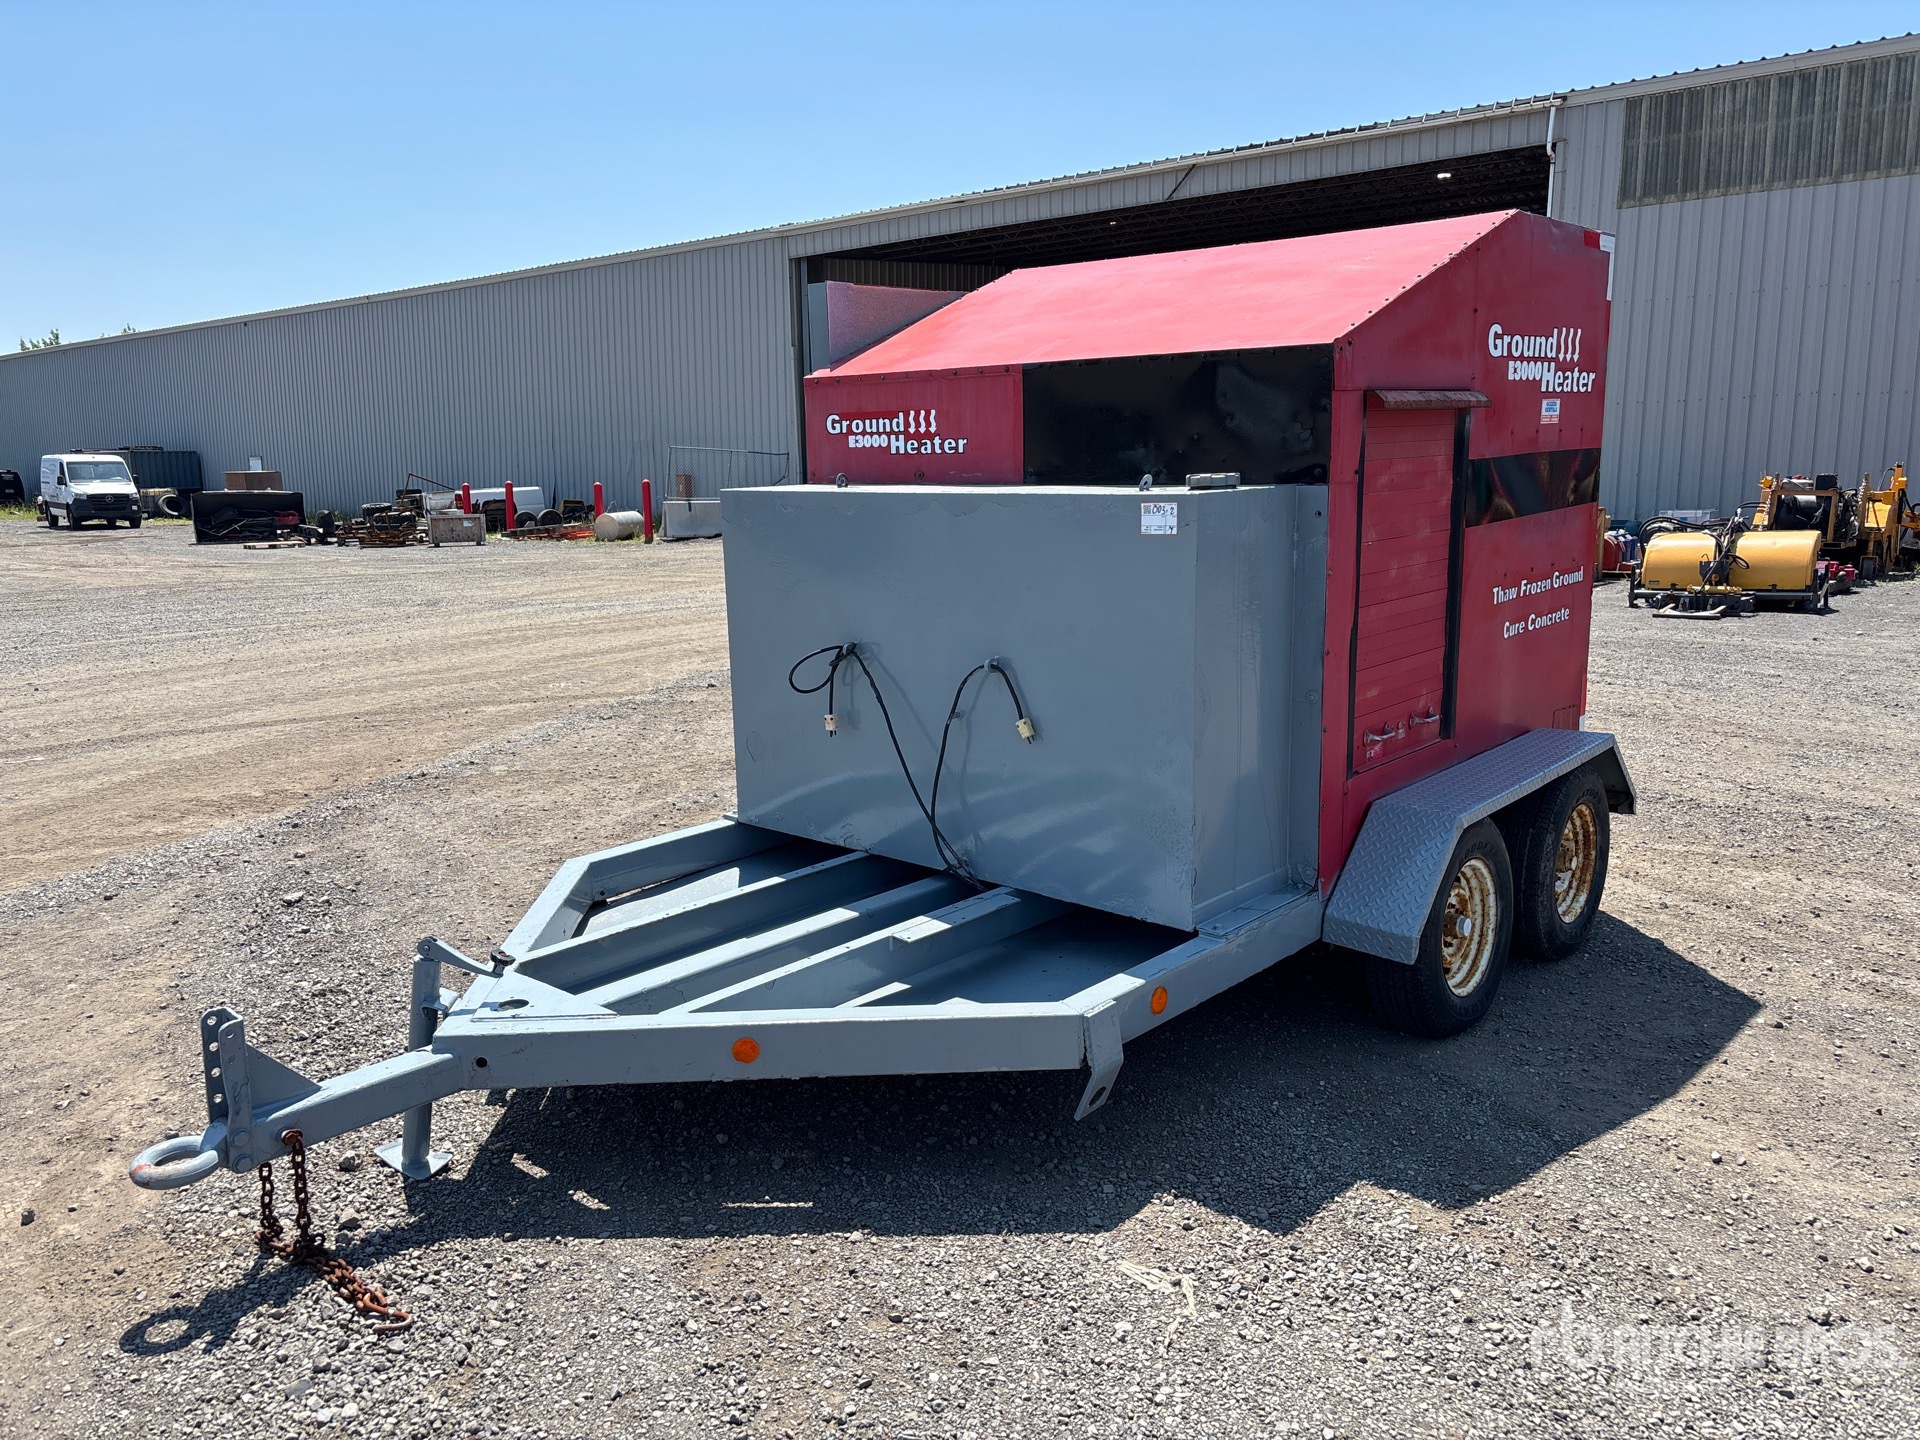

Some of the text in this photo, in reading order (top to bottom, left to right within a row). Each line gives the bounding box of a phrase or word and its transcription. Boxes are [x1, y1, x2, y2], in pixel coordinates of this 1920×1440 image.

[1488, 323, 1558, 358] Ground
[1508, 361, 1596, 392] E3000 Heater
[826, 411, 905, 434] Ground
[848, 434, 968, 455] E3000 Heater
[1493, 565, 1584, 604] Thaw Frozen Ground
[1503, 607, 1570, 639] Cure Concrete
